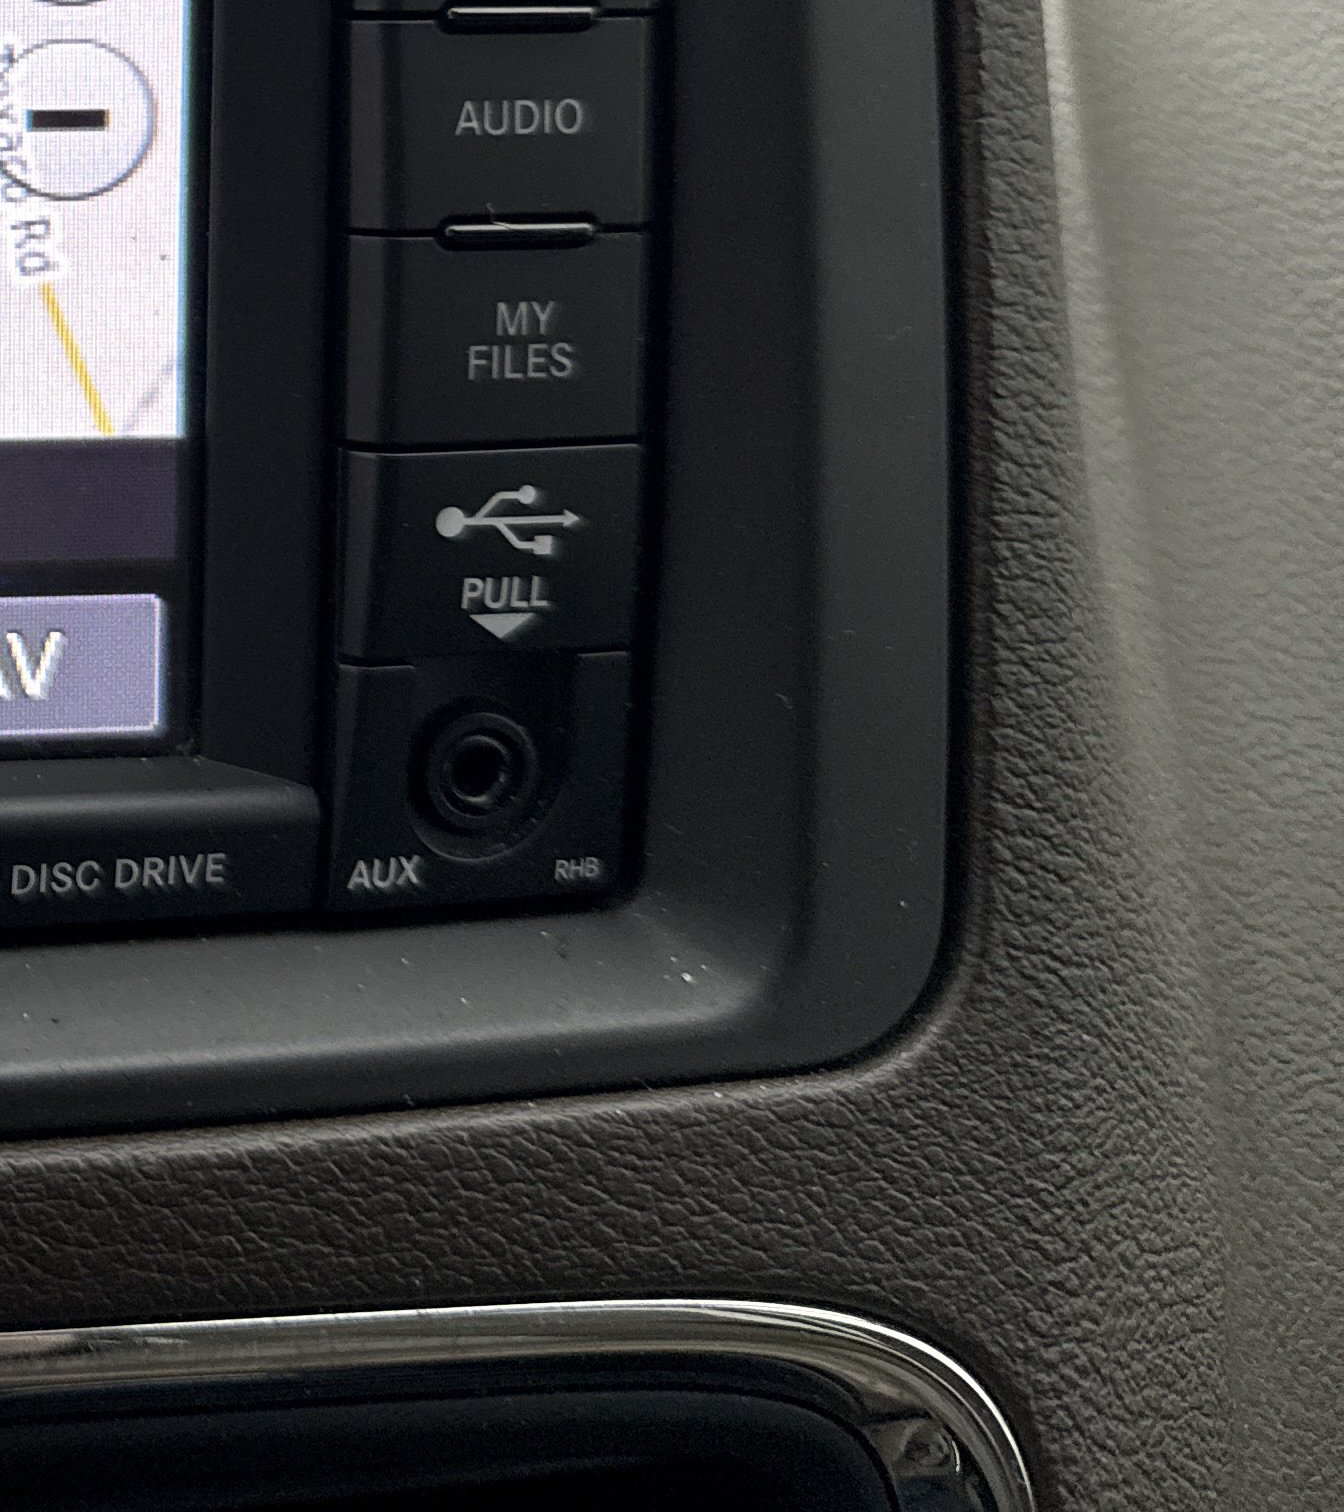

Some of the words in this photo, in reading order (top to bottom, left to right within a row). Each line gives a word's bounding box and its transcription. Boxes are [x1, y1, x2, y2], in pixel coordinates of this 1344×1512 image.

[455, 99, 584, 136] AUDIO
[11, 216, 59, 276] Rd
[496, 301, 555, 336] MY
[467, 342, 575, 380] FILES
[461, 576, 549, 609] PULL
[10, 861, 101, 896] DISC
[114, 852, 227, 890] DRIVE
[347, 854, 422, 890] AUX
